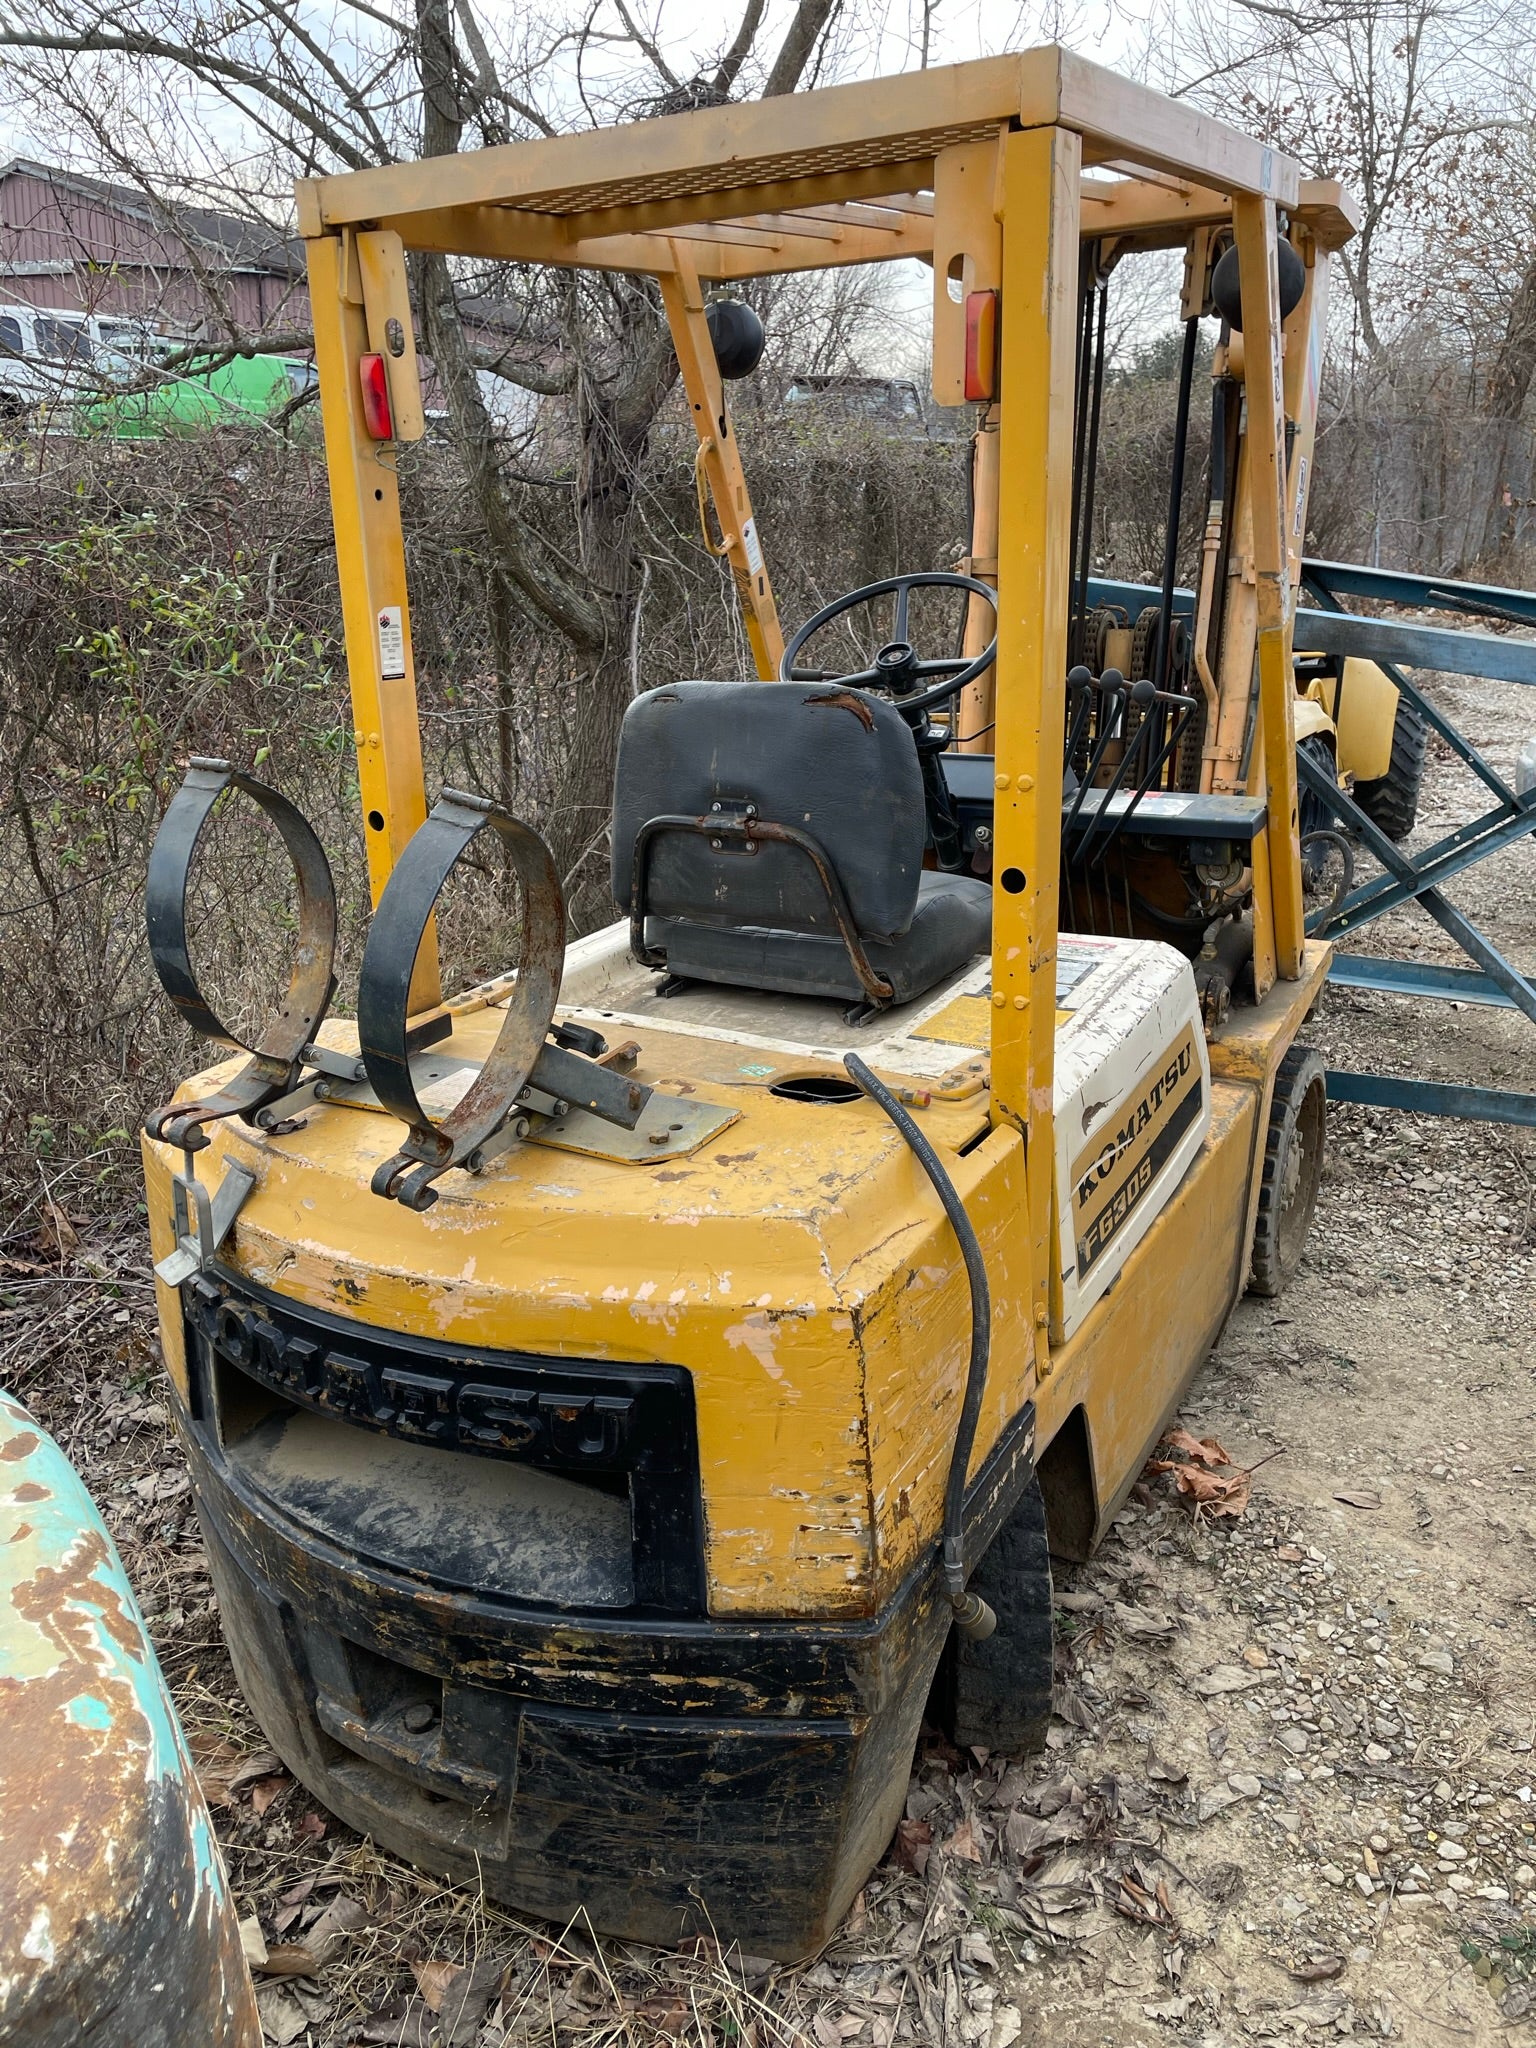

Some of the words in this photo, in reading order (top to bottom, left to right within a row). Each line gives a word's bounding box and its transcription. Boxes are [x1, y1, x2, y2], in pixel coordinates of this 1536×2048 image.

[1079, 1041, 1192, 1209] KOMATSU
[1081, 1156, 1152, 1263] FG30S
[186, 1272, 635, 1459] KOMATSU
